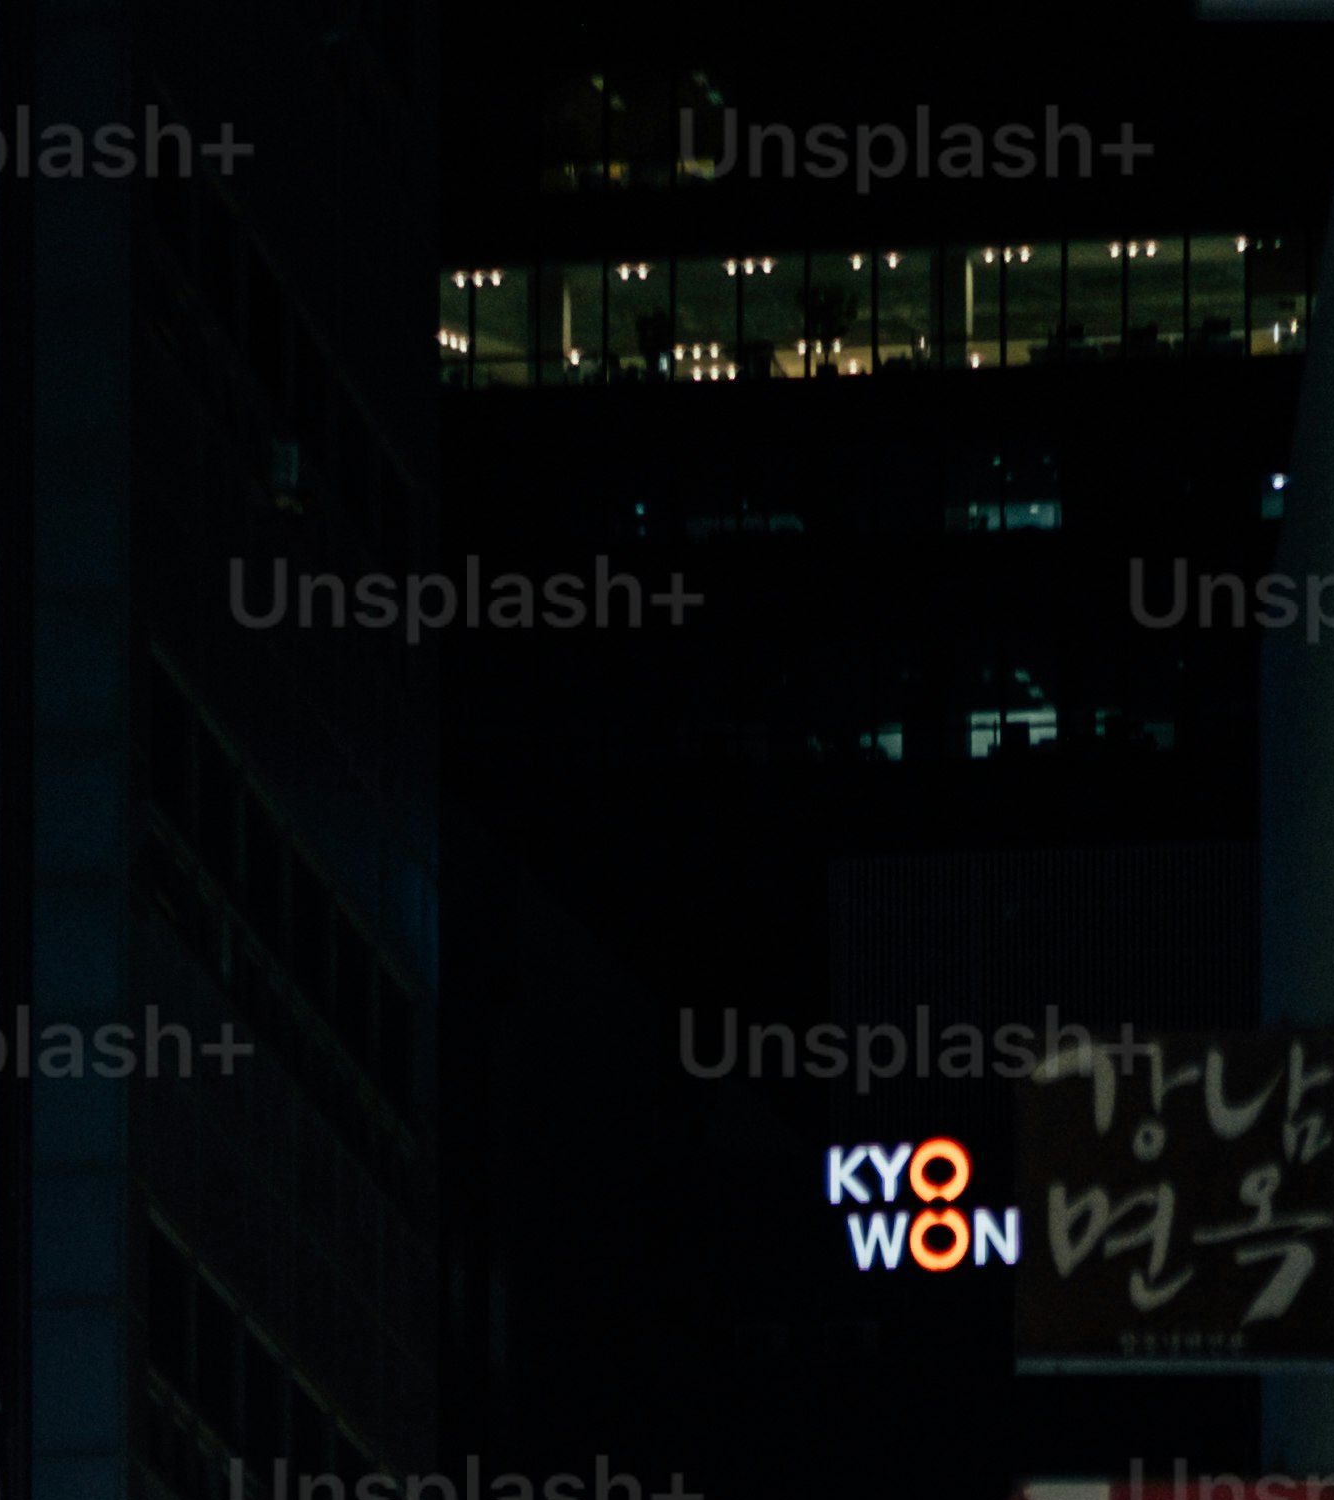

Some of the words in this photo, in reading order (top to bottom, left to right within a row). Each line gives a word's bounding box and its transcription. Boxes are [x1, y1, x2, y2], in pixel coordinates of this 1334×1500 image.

[1030, 1040, 1333, 1164] 강남
[827, 1136, 972, 1205] KYO
[847, 1207, 1022, 1273] WON
[1048, 1161, 1334, 1326] 면옥
